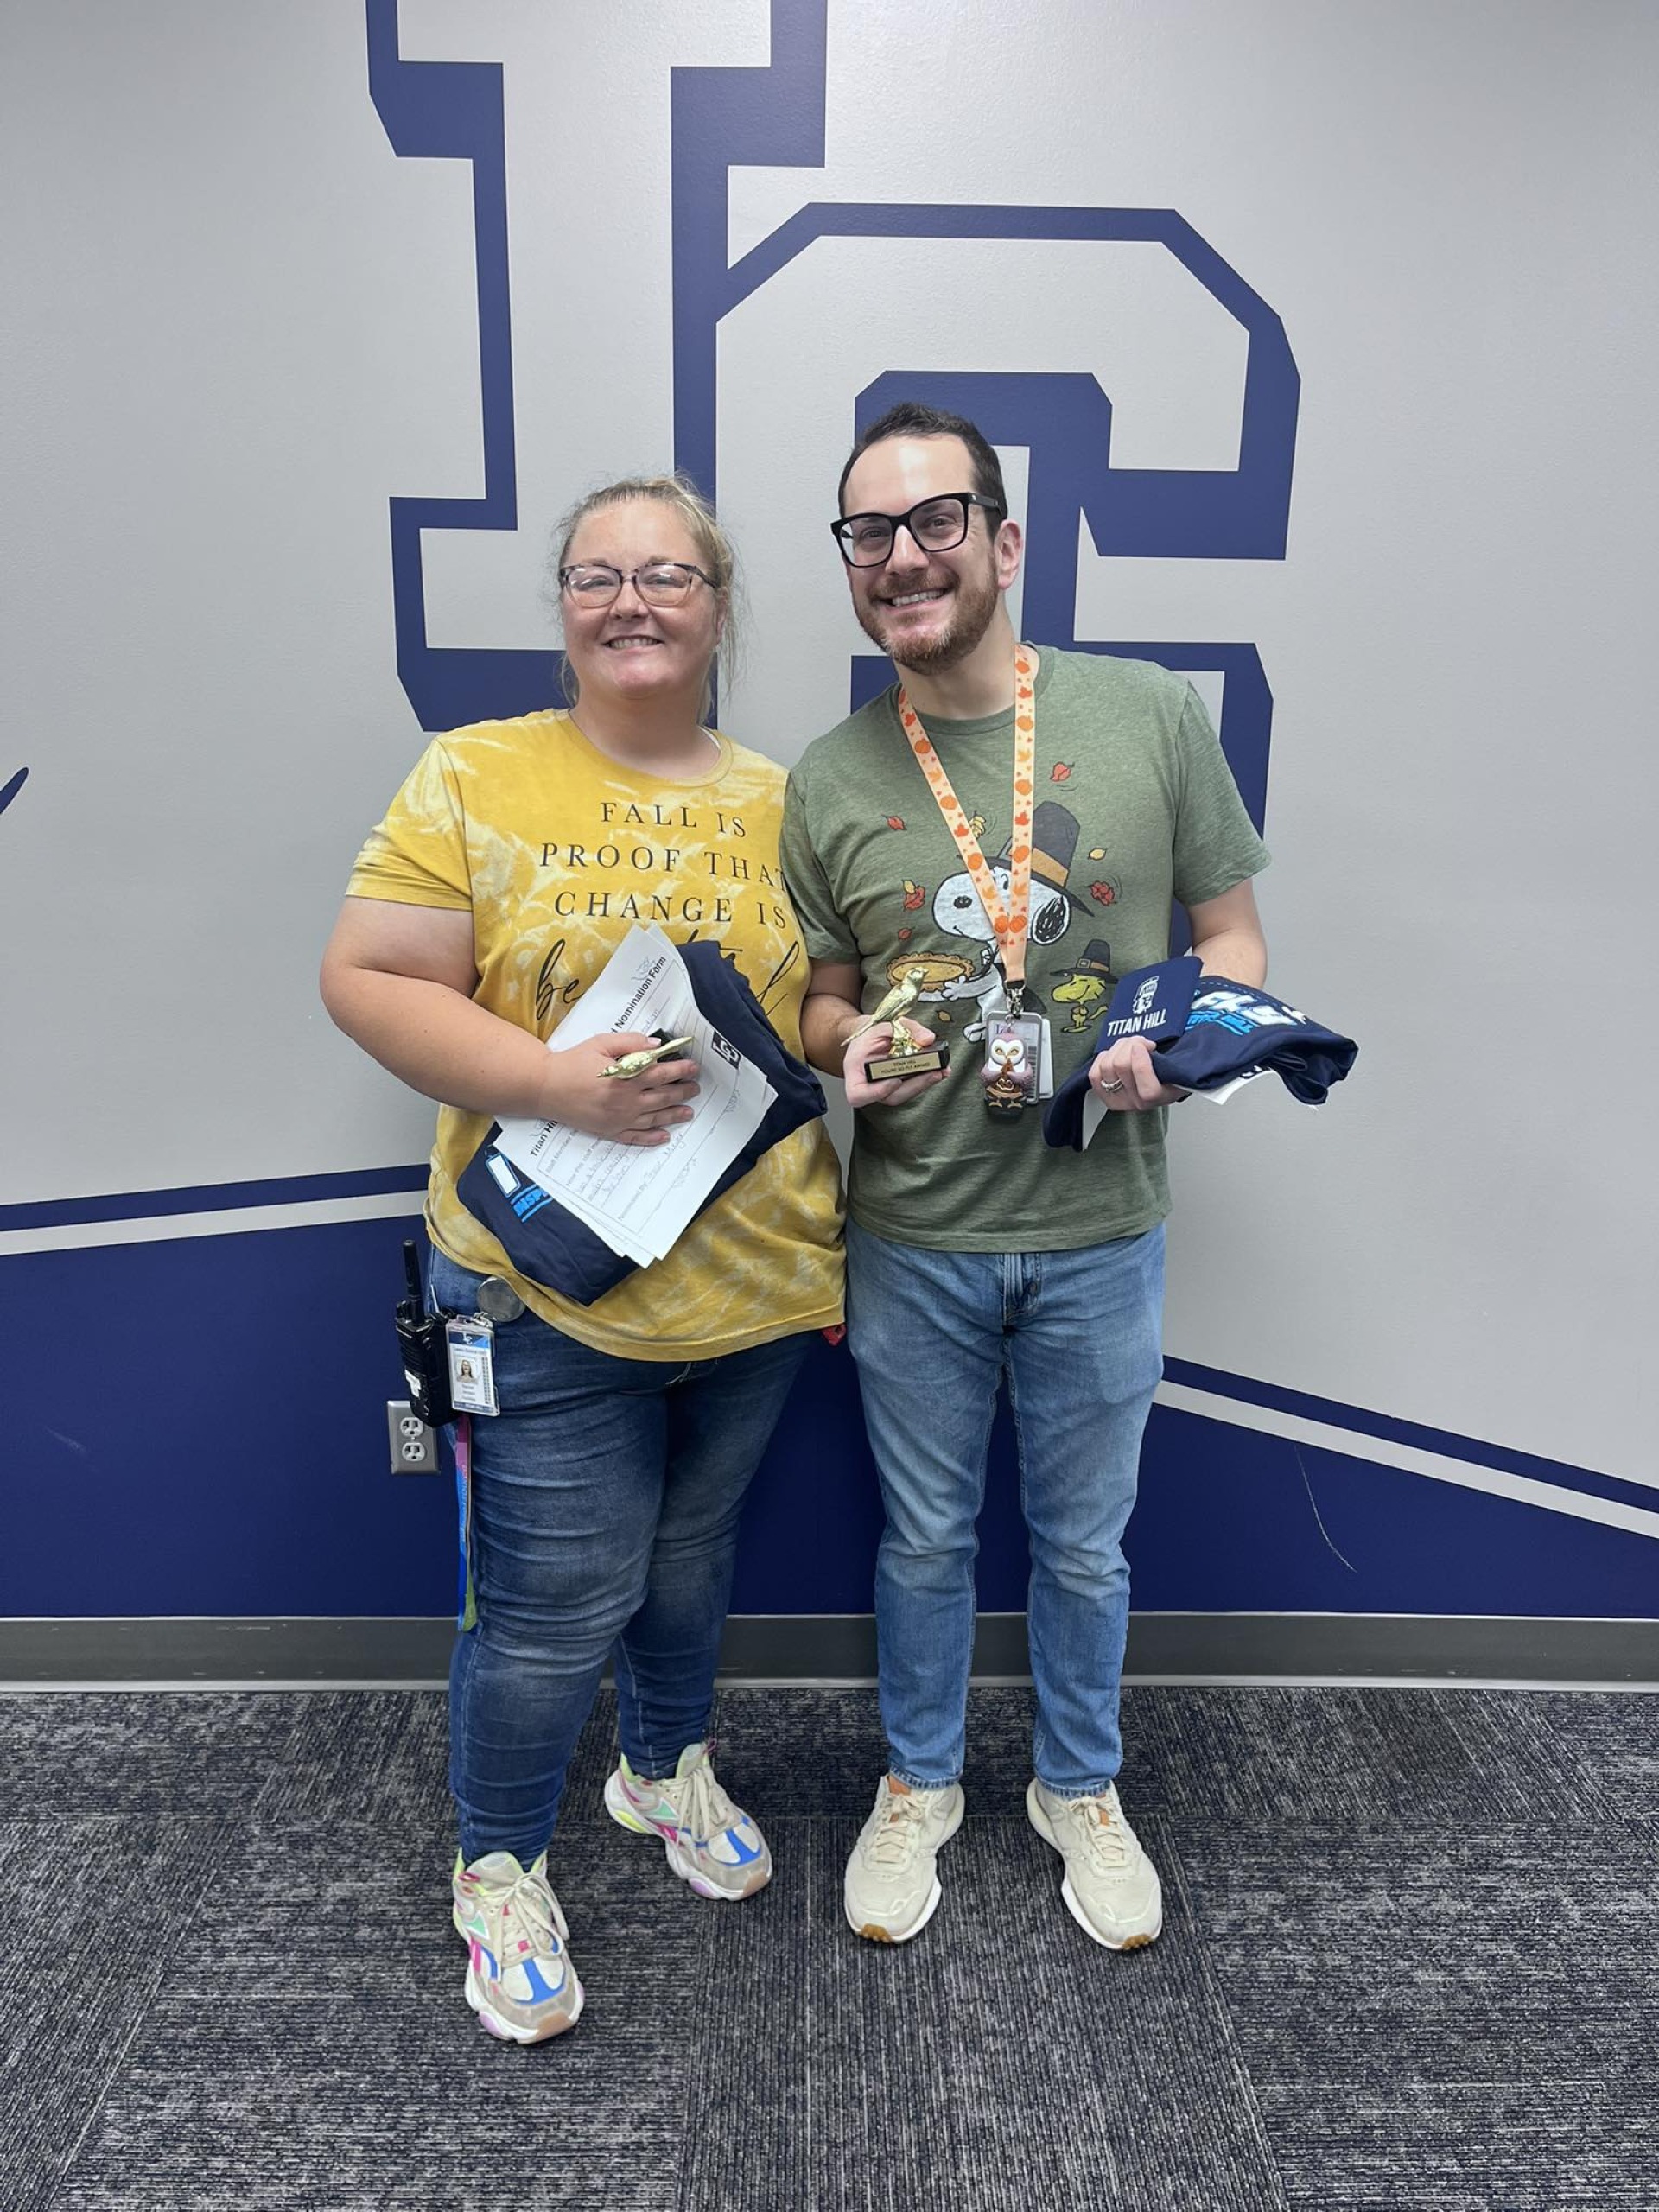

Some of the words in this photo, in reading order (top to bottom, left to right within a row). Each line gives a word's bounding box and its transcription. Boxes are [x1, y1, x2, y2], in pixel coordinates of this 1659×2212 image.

[601, 802, 697, 829] FALL
[717, 812, 747, 838] IS
[539, 842, 681, 873] PROOF
[703, 851, 787, 892] THAT
[555, 891, 734, 922] CHANGE
[756, 901, 787, 929] IS
[614, 977, 653, 1029] Nomination
[649, 956, 667, 979] Form
[1107, 1014, 1142, 1037] TITAN
[1142, 1008, 1166, 1031] HILL
[531, 1133, 549, 1158] Titan
